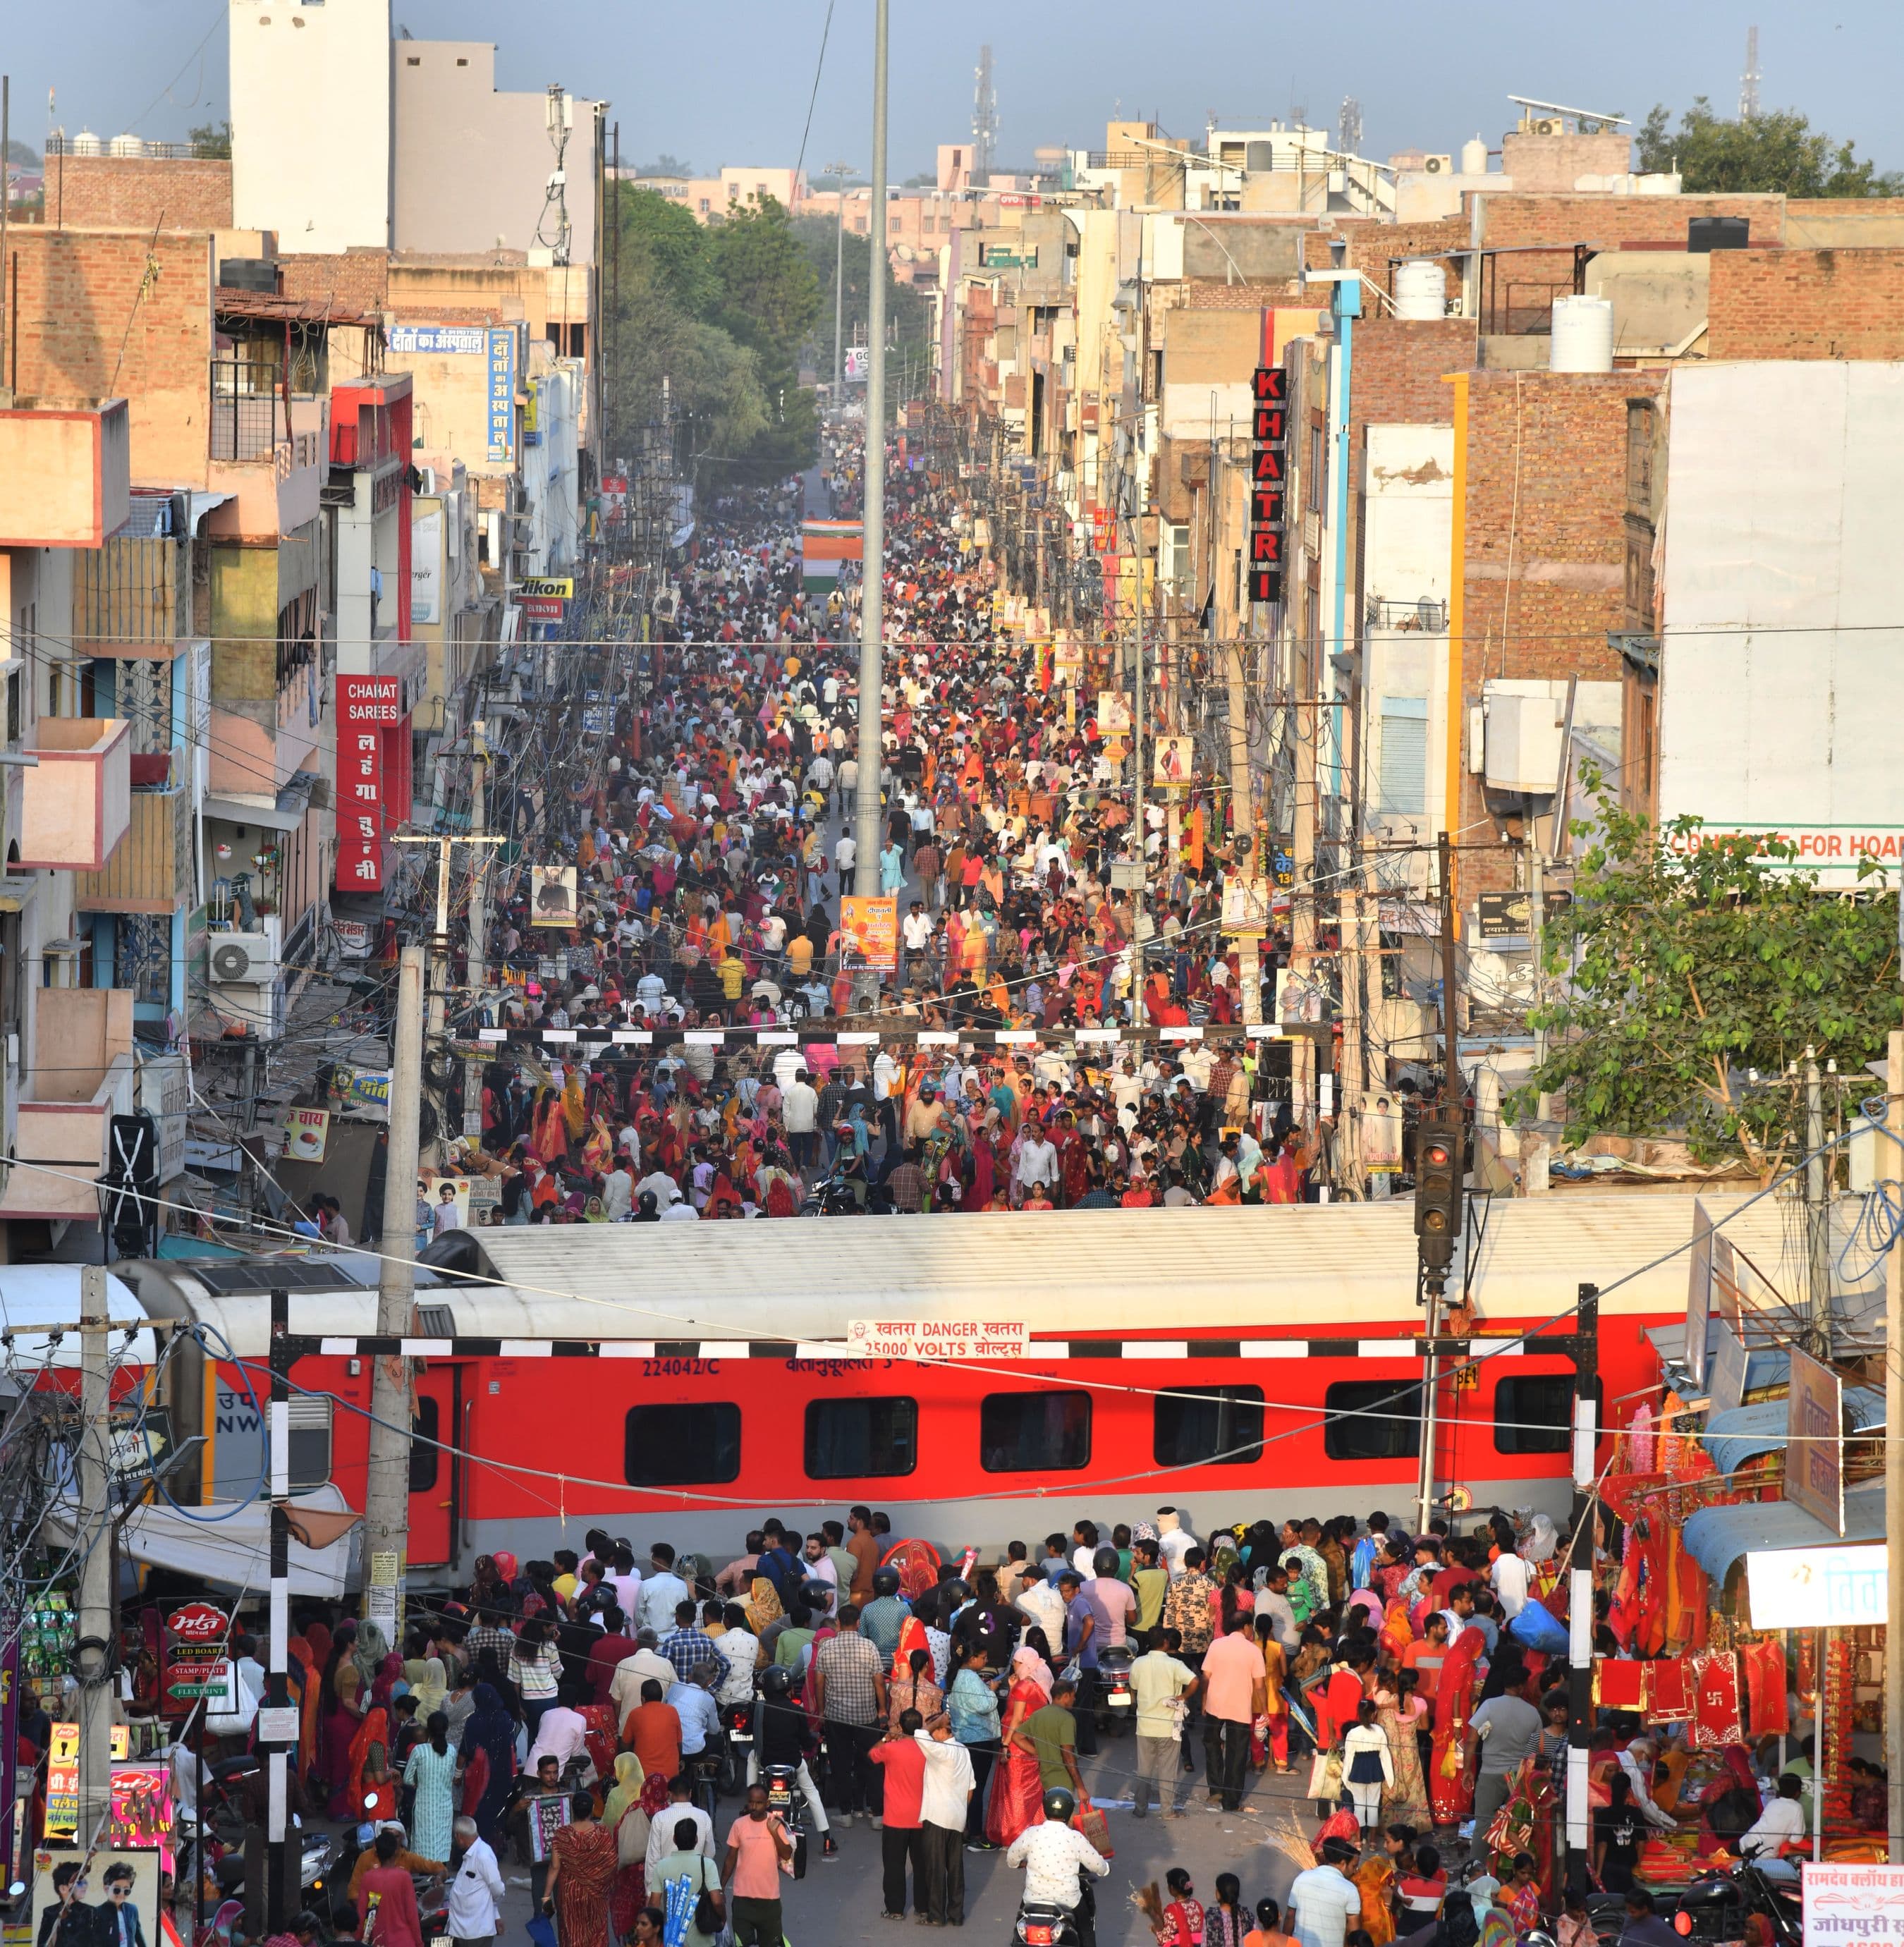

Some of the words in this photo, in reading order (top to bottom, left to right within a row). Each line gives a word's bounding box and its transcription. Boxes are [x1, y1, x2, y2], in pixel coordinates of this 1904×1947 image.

[418, 334, 434, 348] का
[1255, 372, 1281, 598] KHATRI
[412, 570, 432, 580] erger
[515, 580, 566, 595] Nikon
[527, 604, 559, 614] anon
[348, 684, 397, 698] CHAHAT
[349, 705, 397, 719] SAREES
[1800, 835, 1842, 857] FOR
[299, 1111, 325, 1127] चाय
[875, 1323, 917, 1336] खतरा
[923, 1323, 977, 1336] DANGER
[982, 1322, 1024, 1336] खतरा
[865, 1342, 908, 1355] 25000
[916, 1342, 966, 1355] VOLTS
[643, 1358, 719, 1377] 224042/C
[978, 1611, 995, 1635] 3
[176, 1666, 225, 1675] STAMP/PLATE
[1807, 1868, 1848, 1886] रामदेव
[1890, 1873, 1904, 1887] हा
[1812, 1913, 1890, 1937] जोधपुरी
